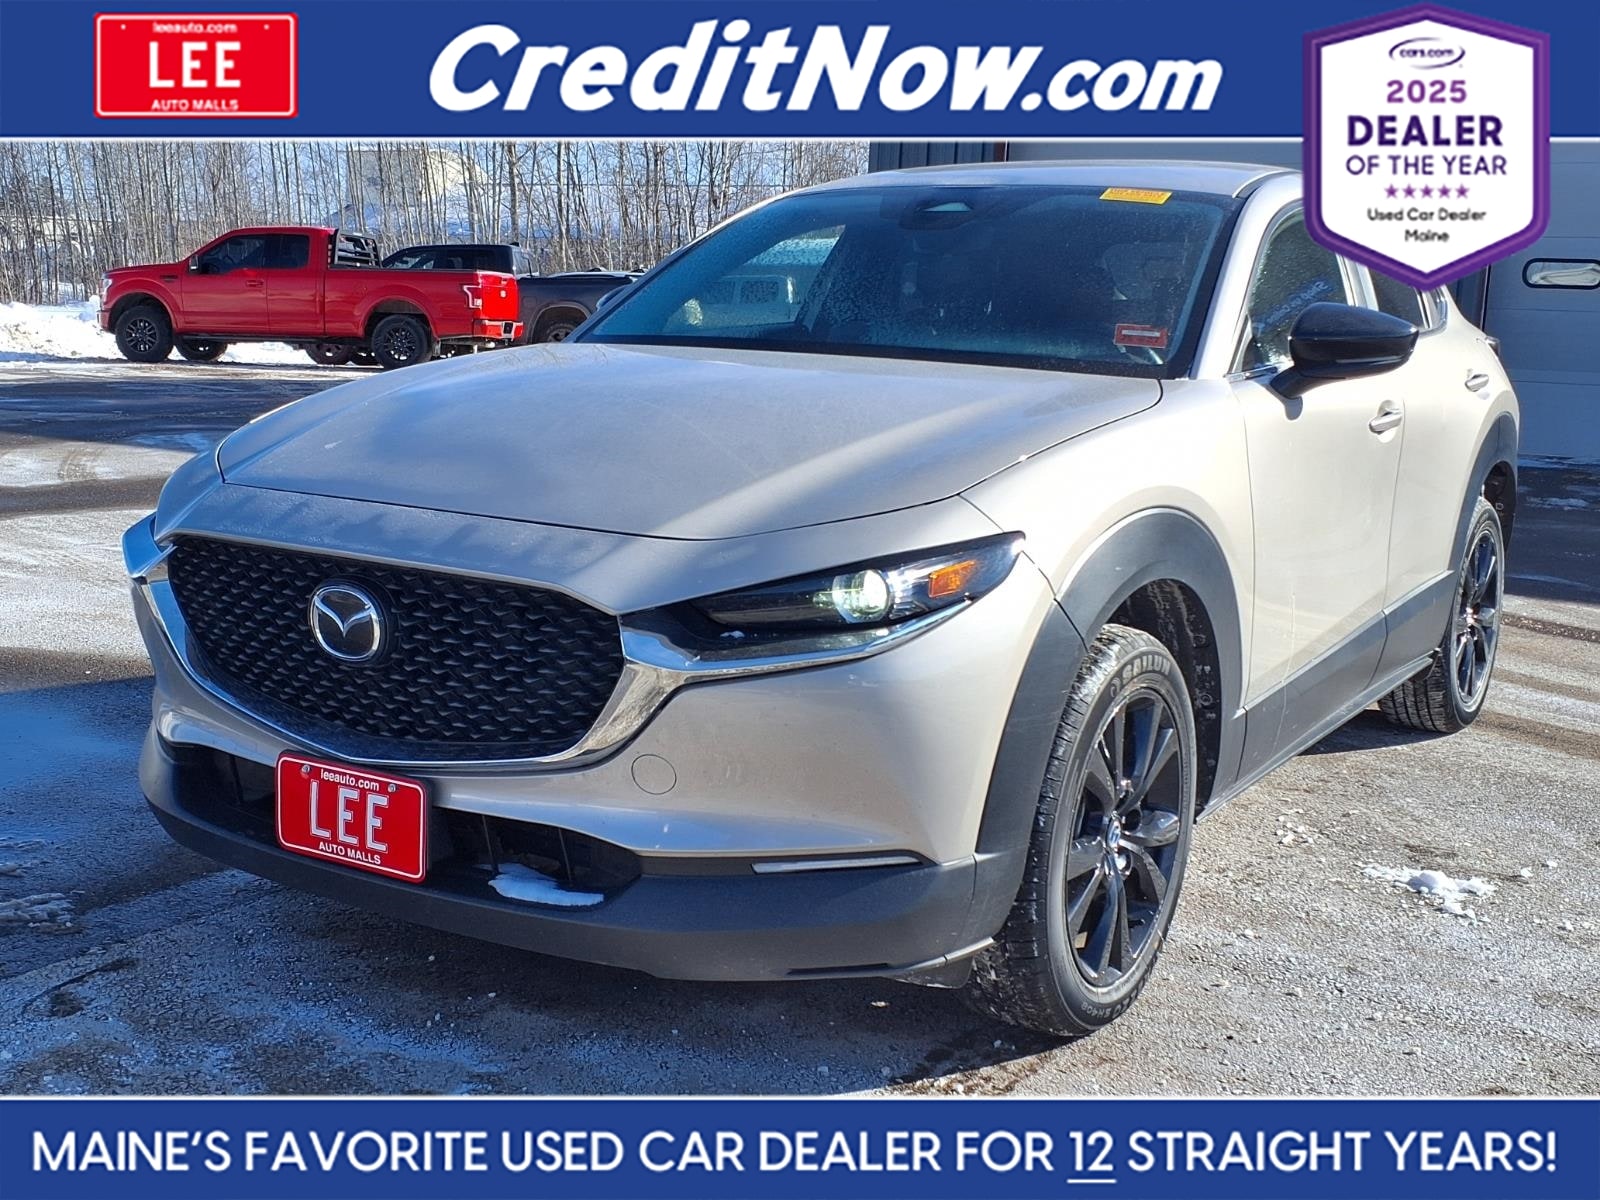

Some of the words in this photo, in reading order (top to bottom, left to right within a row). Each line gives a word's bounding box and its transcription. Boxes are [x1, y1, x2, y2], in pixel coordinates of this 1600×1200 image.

[1122, 654, 1171, 683] SAILUN
[320, 768, 380, 792] leeauto.com
[310, 779, 389, 853] LEE
[318, 842, 346, 856] AUTO
[347, 848, 381, 865] MALLS
